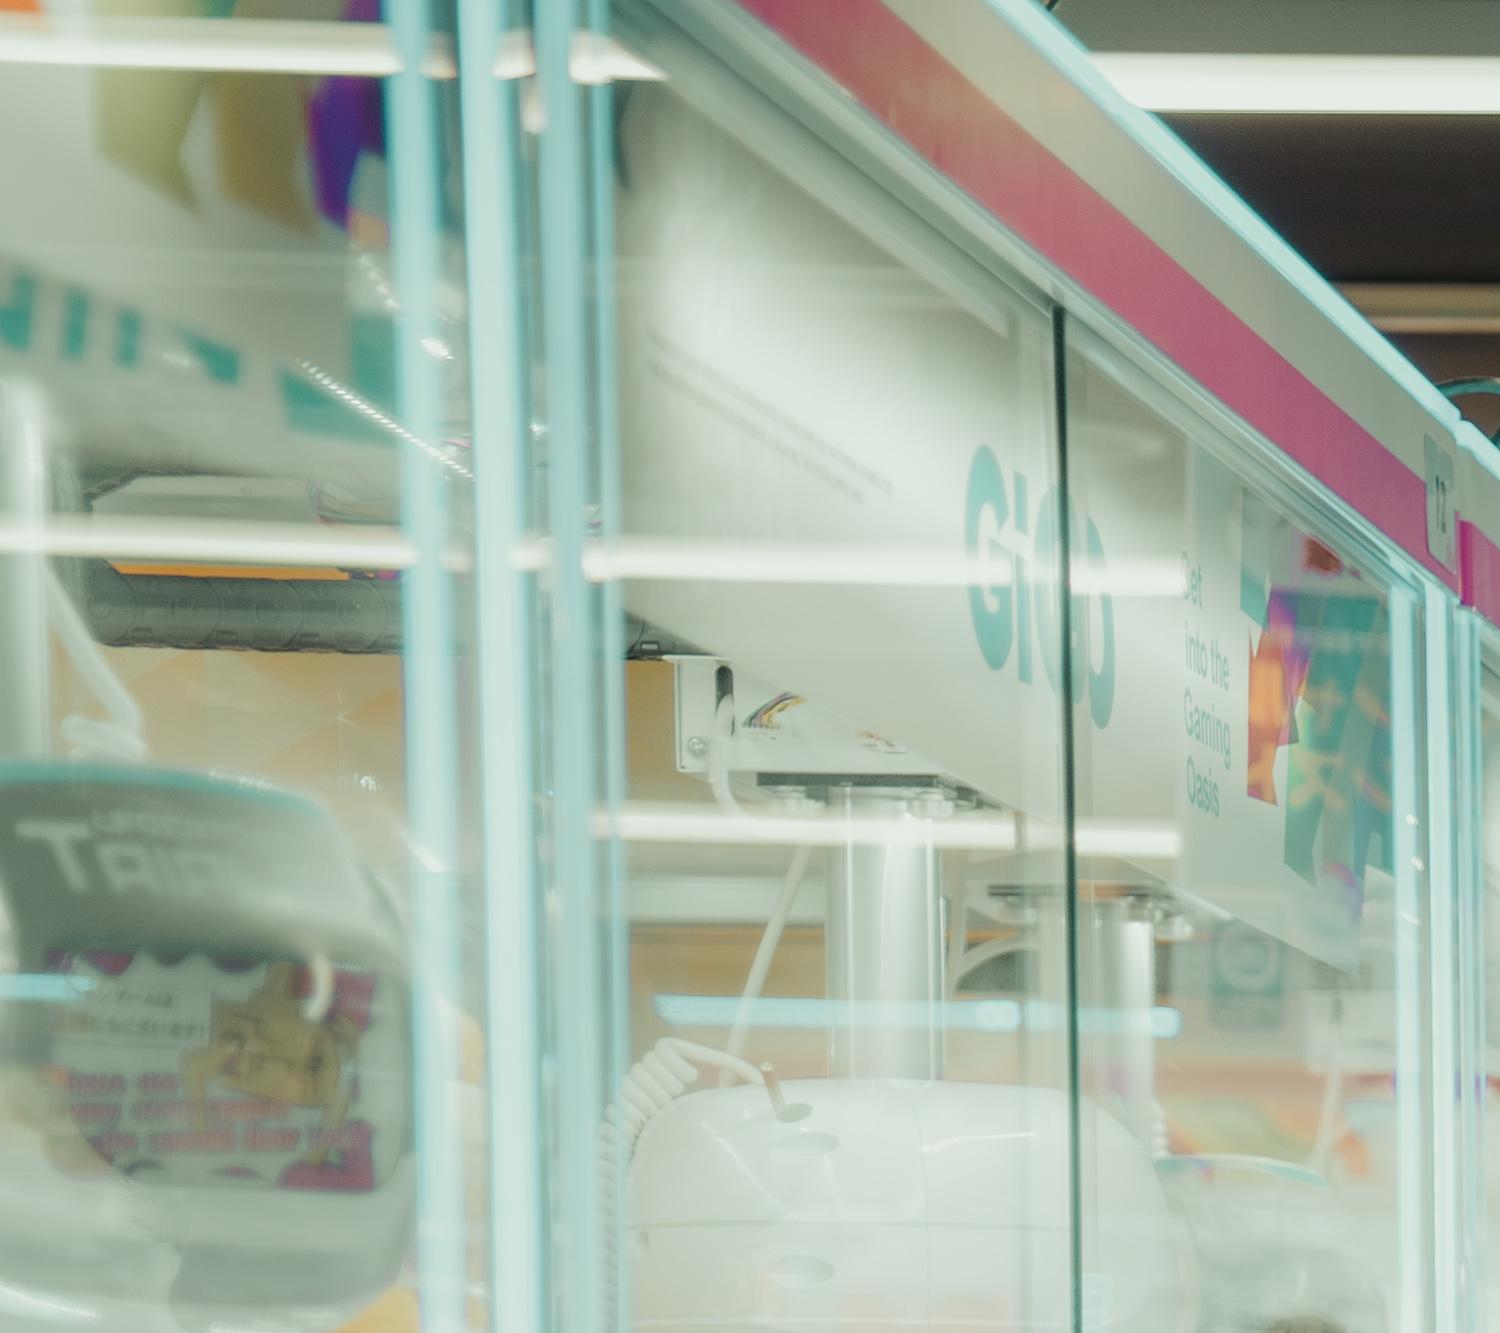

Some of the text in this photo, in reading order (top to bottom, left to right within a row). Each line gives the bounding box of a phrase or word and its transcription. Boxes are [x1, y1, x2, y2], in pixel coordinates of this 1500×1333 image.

[1184, 620, 1231, 692] into the
[1183, 687, 1232, 769] Gaming
[1186, 754, 1222, 819] Oasis
